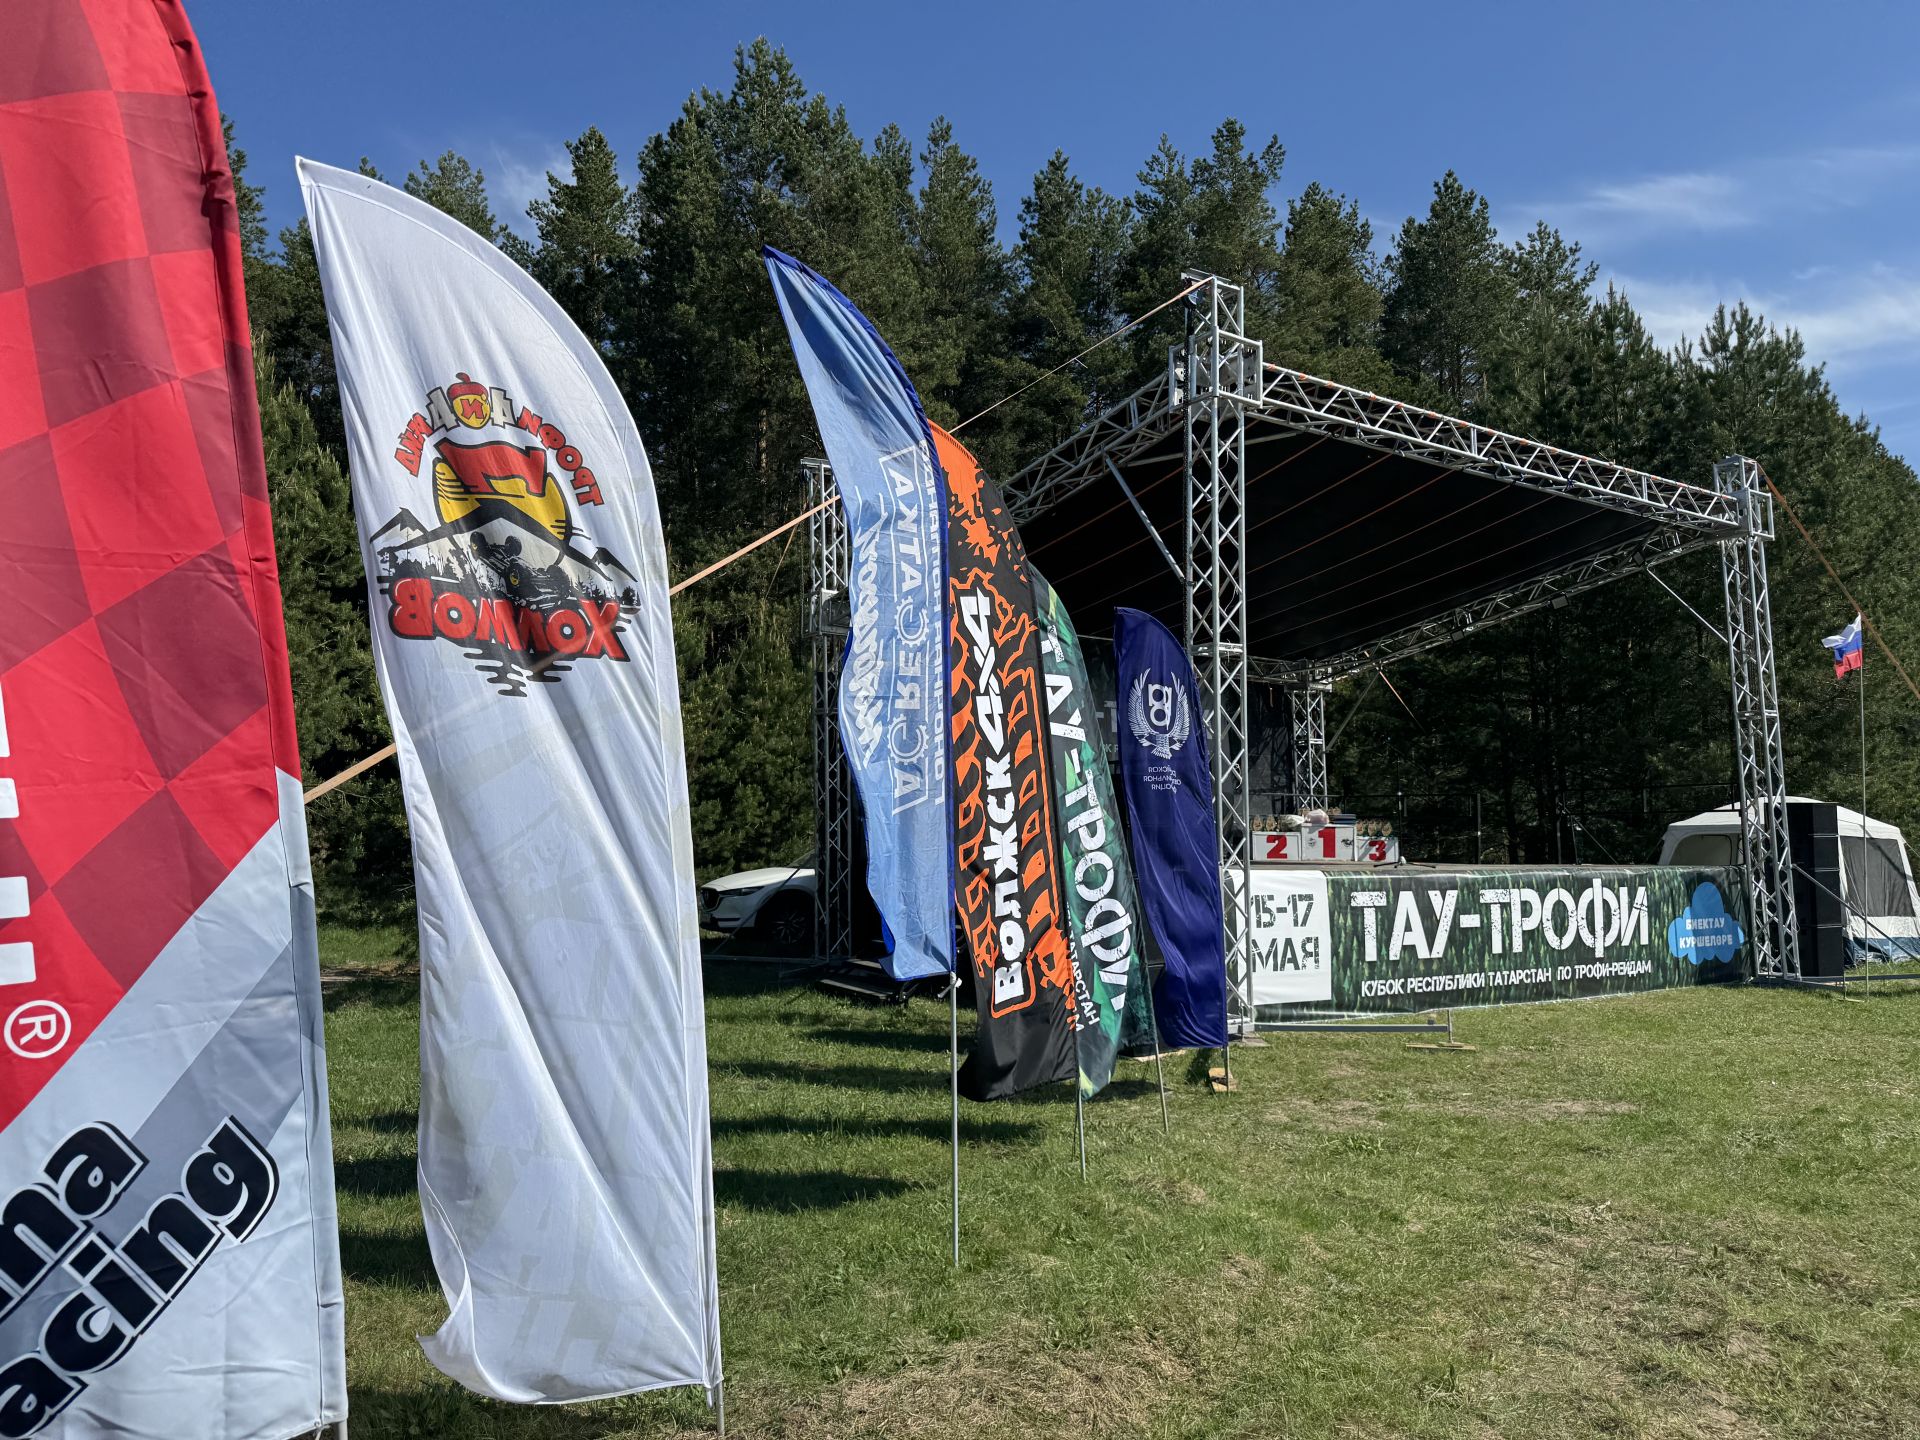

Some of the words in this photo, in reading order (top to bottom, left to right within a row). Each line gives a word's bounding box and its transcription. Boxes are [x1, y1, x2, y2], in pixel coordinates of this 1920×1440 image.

[1266, 835, 1288, 859] 2
[1318, 827, 1336, 858] 1
[1368, 840, 1387, 861] 3
[1250, 894, 1314, 928] 15-17
[1350, 878, 1649, 962] ТАУ-ТРОФИ
[1251, 936, 1320, 973] МАЯ
[1361, 979, 1404, 998] КУБОК
[1407, 972, 1486, 994] РЕСПУБЛИКИ
[1488, 967, 1552, 987] ТАТАРСТАН
[1557, 965, 1572, 981] ПО
[1574, 959, 1652, 981] ТРОФИ-РЕЙДАМ
[0, 1120, 150, 1321] na
